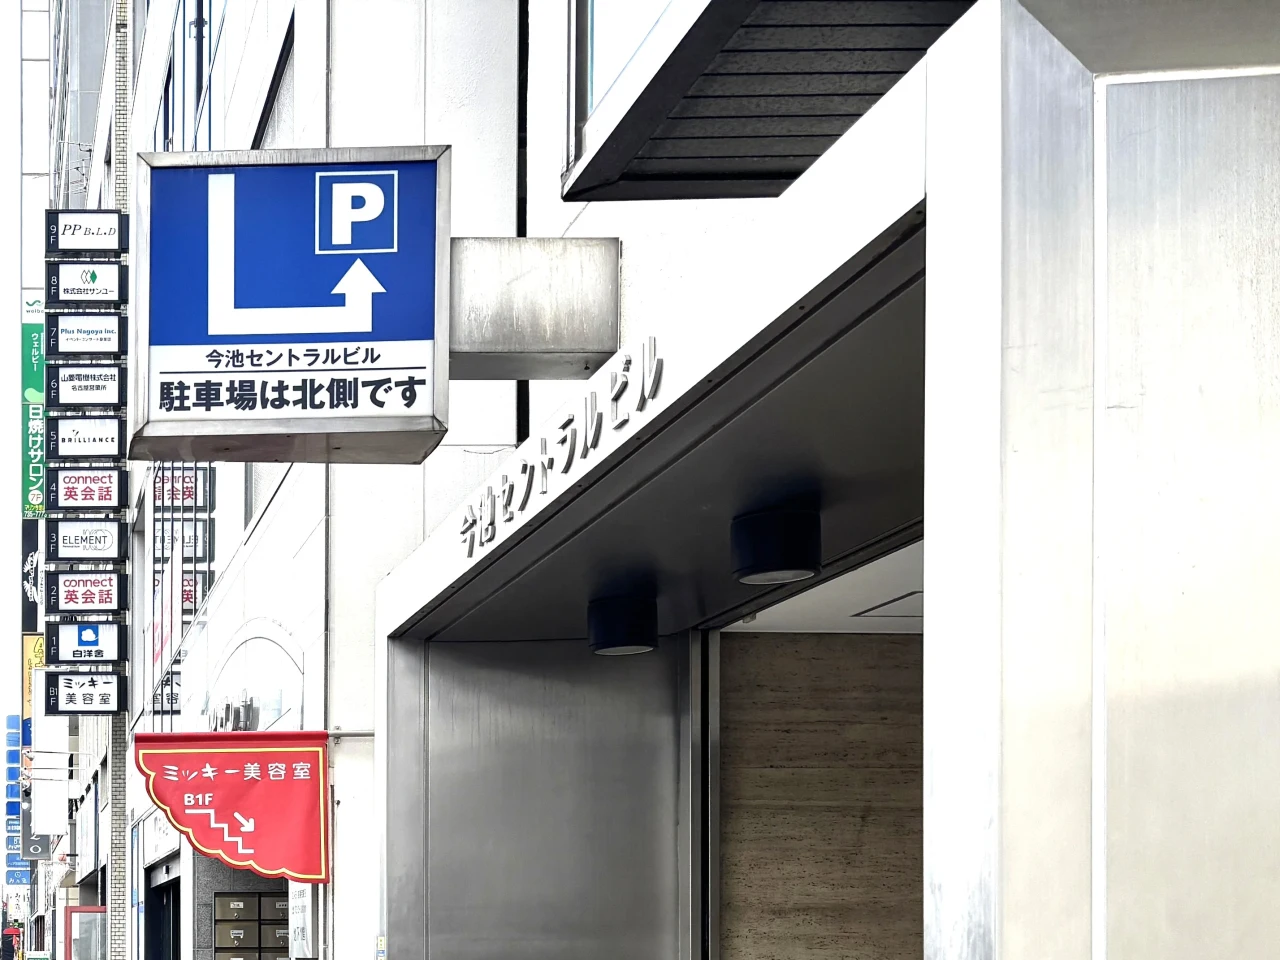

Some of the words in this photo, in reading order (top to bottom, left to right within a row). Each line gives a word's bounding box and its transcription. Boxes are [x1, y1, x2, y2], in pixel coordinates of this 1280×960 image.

[331, 182, 385, 245] P
[61, 224, 82, 236] PP
[63, 287, 115, 295] 株式会社サンユー
[77, 328, 103, 336] Nagoya
[31, 332, 39, 372] ウェルビー
[205, 347, 382, 369] 今池セントラルビル
[158, 376, 426, 412] 駐車場は北側です
[27, 404, 44, 491] 日焼けサロン
[460, 336, 664, 558] 今池セントラルビル
[63, 473, 114, 485] connect
[63, 486, 113, 501] 英会話
[62, 535, 108, 545] ELEMENT
[63, 576, 114, 588] connect
[63, 590, 113, 605] 英会話
[63, 678, 113, 689] ミッキー
[65, 692, 111, 705] 美容室
[162, 762, 312, 782] ミッキー美容室
[184, 793, 214, 806] B1F
